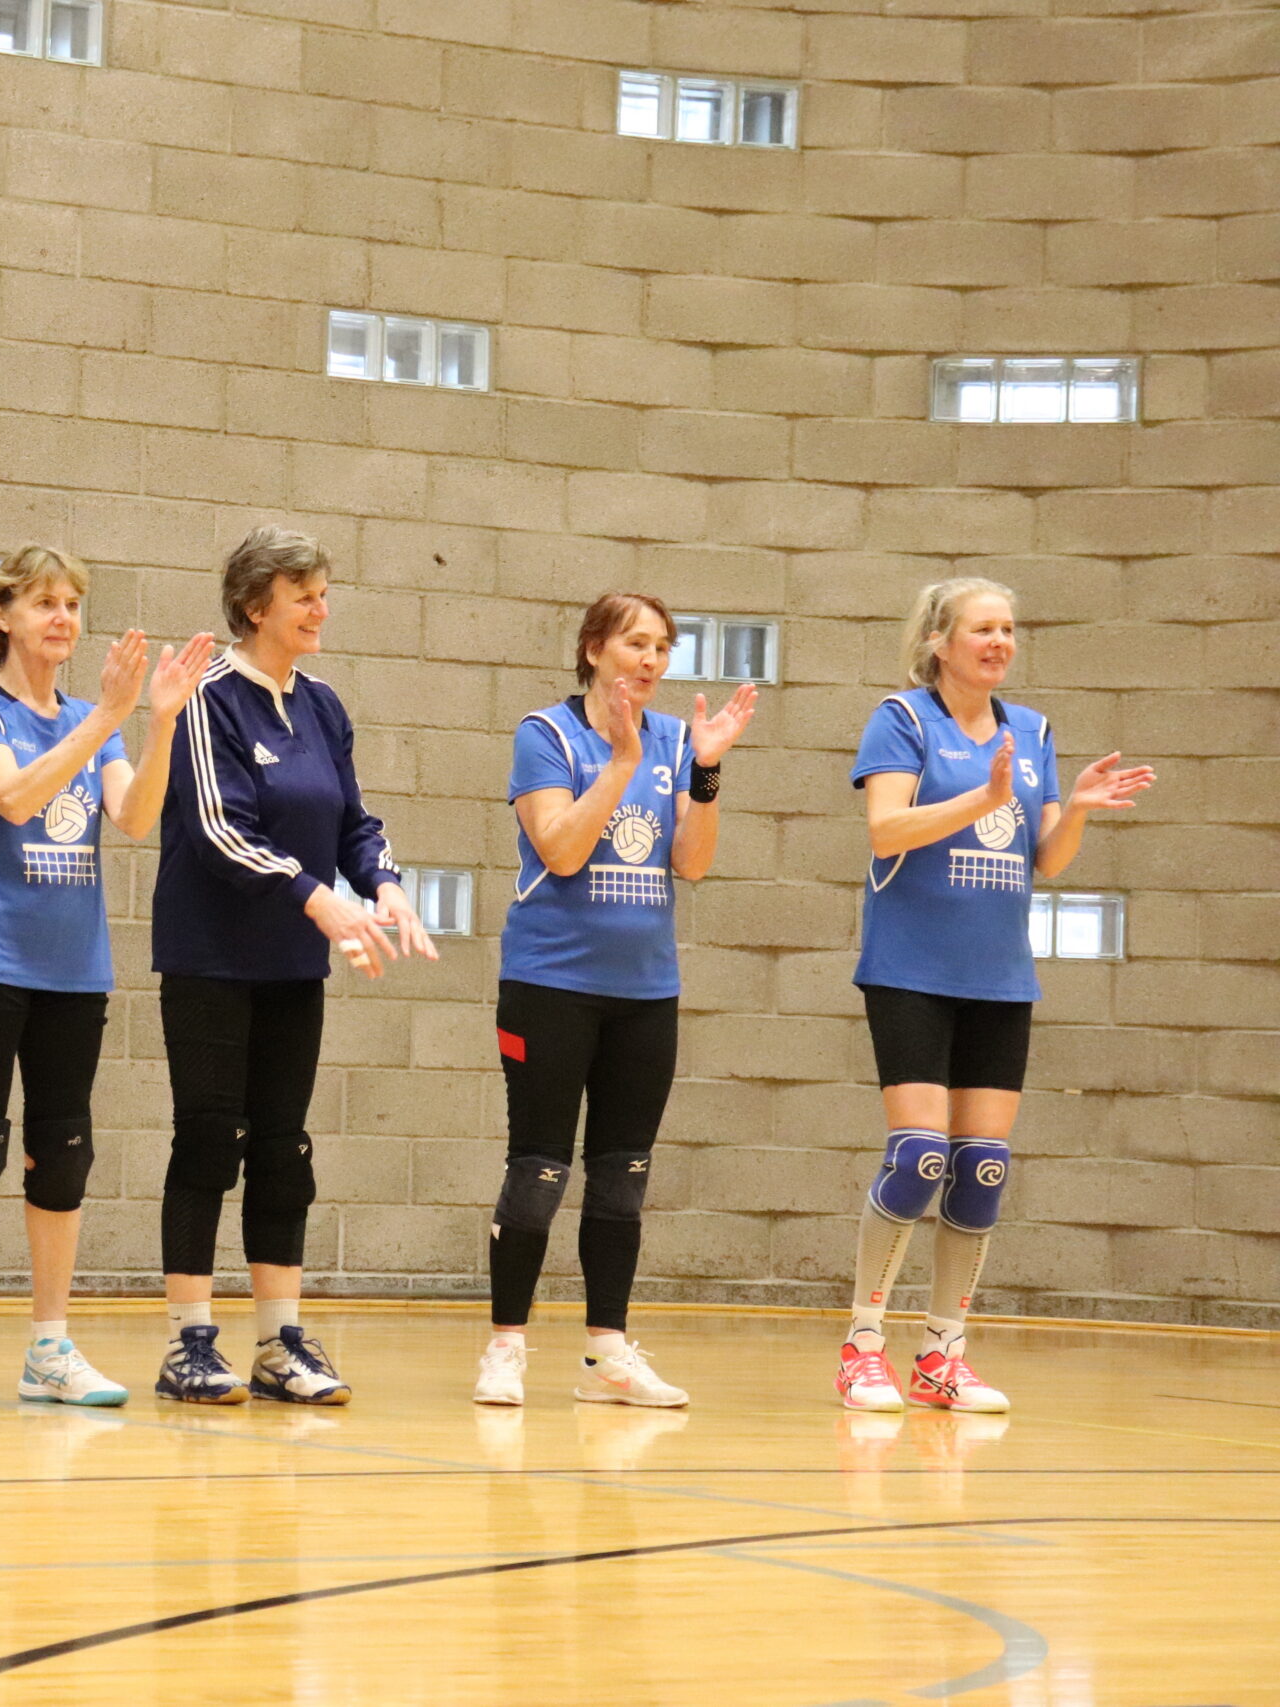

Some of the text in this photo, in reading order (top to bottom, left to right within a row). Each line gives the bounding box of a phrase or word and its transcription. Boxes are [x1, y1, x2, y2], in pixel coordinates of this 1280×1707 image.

[652, 765, 673, 795] 3
[1017, 758, 1039, 788] 5
[73, 784, 98, 816] SVK
[1008, 796, 1026, 827] SVK
[644, 809, 663, 840] SVK
